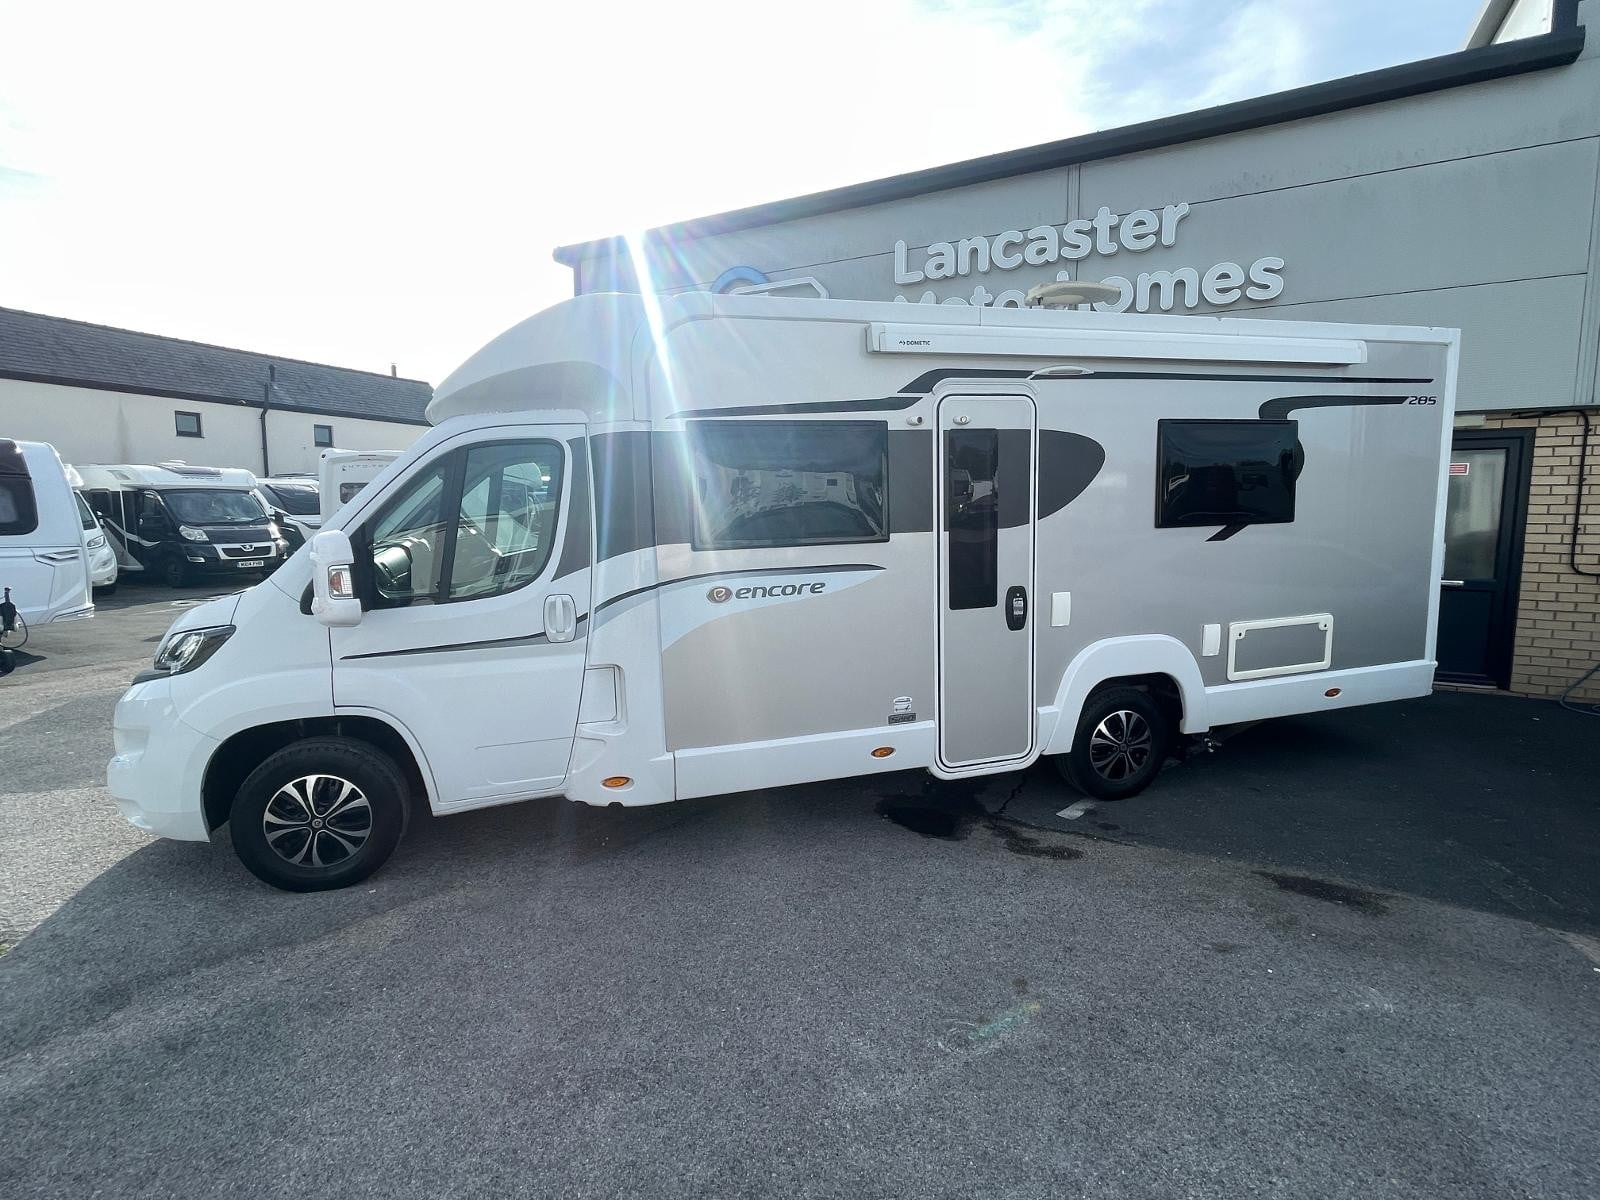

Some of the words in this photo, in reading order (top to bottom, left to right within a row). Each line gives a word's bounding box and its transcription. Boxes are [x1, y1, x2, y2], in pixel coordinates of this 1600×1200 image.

[894, 202, 1191, 285] Lancaster
[1408, 396, 1437, 405] 285
[734, 582, 826, 600] encore
